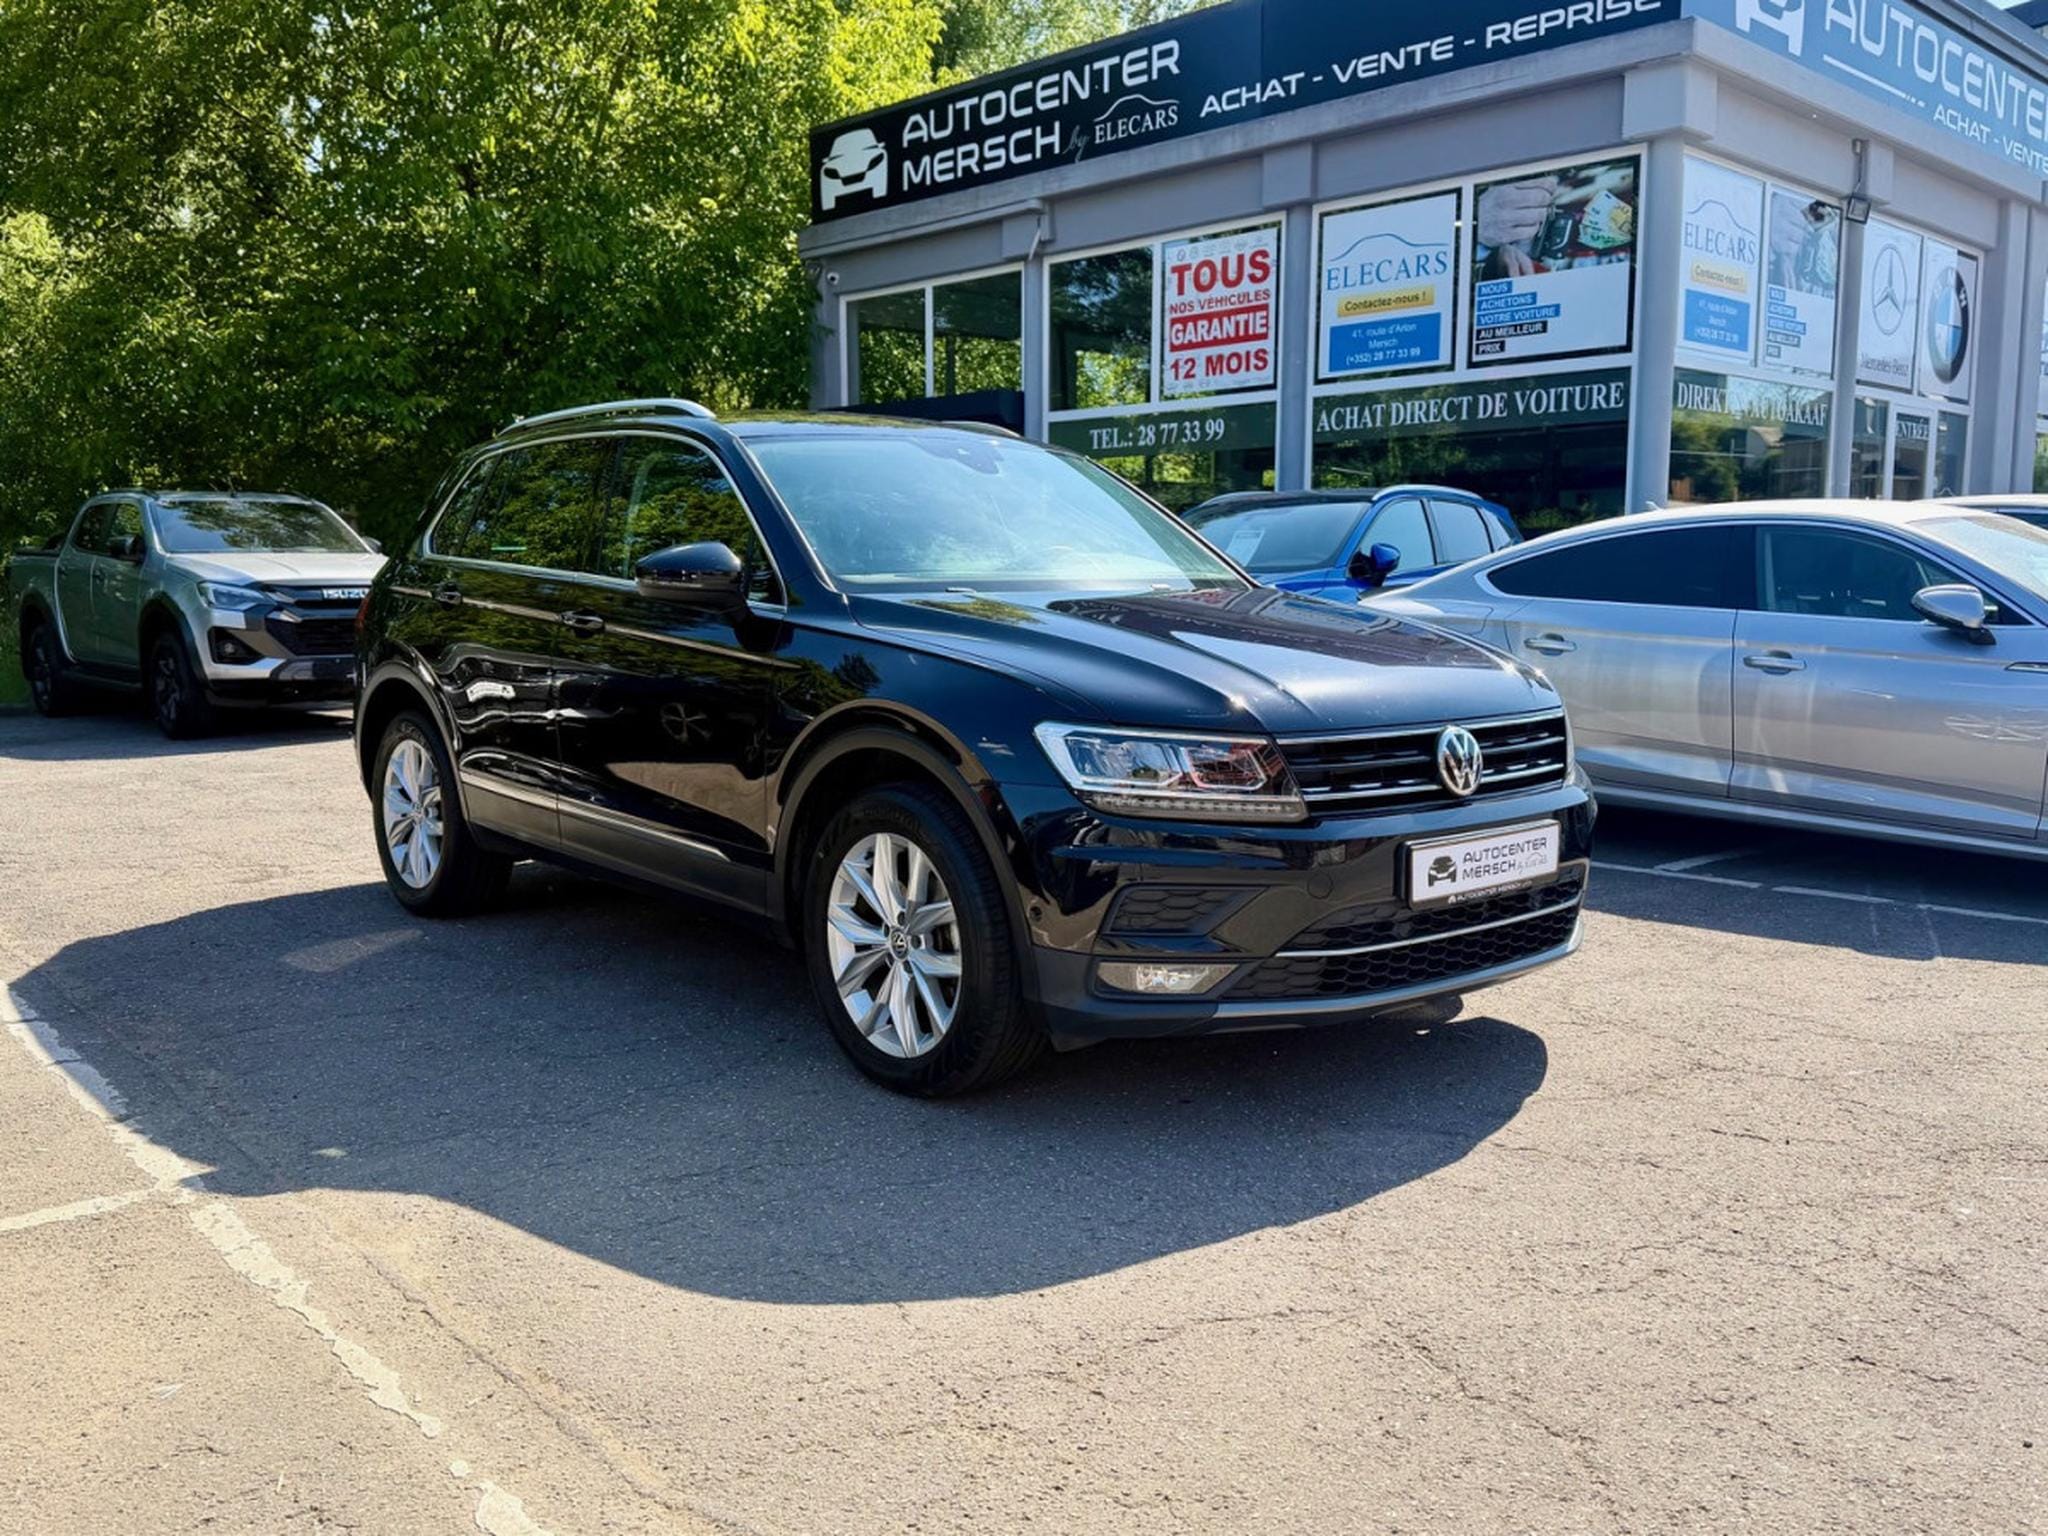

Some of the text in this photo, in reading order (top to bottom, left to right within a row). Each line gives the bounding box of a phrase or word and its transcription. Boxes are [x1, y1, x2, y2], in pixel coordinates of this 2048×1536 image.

[1199, 72, 1305, 118] ACHAT
[1331, 35, 1455, 84] VENTE
[1824, 0, 2048, 142] AUTOCENTE
[902, 39, 1181, 148] AUTOCENTER
[1933, 103, 1991, 145] ACHAT
[902, 121, 1061, 191] MERSCH
[1094, 105, 1179, 144] ELECARS
[1683, 221, 1757, 265] ELECARS
[1170, 249, 1271, 296] TOUS
[1326, 251, 1449, 291] ELECARS
[1480, 295, 1533, 310] ACHETONS
[1481, 283, 1508, 295] NOUS
[1169, 300, 1195, 315] NOS
[1480, 306, 1556, 325] VOTRE VOITURE
[1171, 311, 1267, 346] GARANTIE
[1479, 322, 1543, 339] AU MEILLEUR
[1170, 348, 1269, 381] 12 MOIS
[1316, 381, 1625, 433] ACHAT DIRECT DE VOITURE
[1089, 418, 1225, 450] TEL.: 28 77 33 99
[322, 588, 370, 599] ISUZU
[1463, 837, 1547, 863] AUTOCENTER
[1462, 859, 1516, 880] MERSCH
